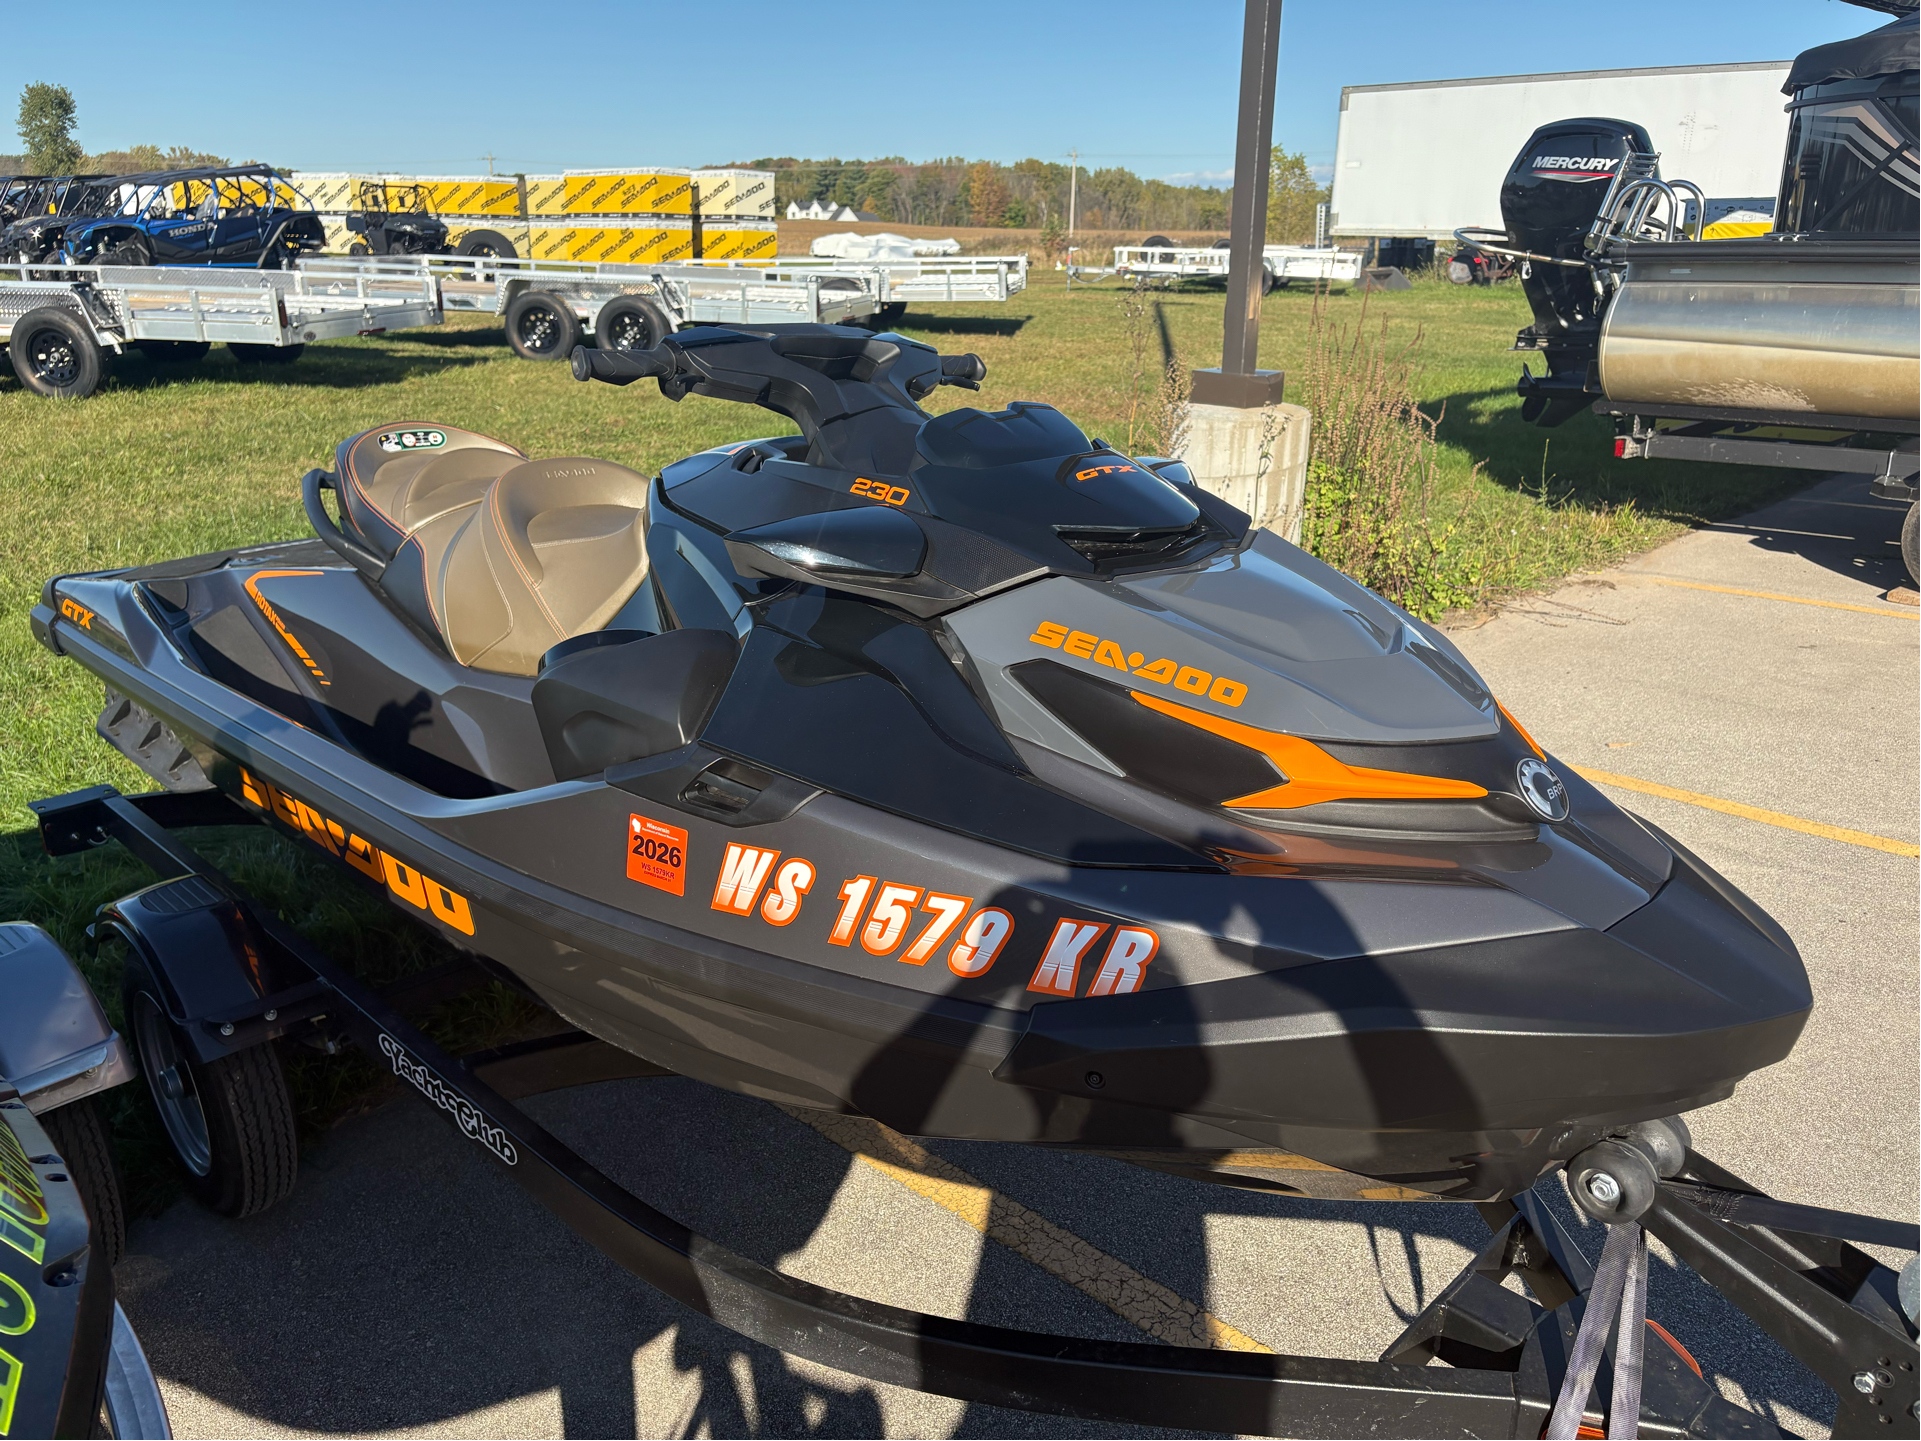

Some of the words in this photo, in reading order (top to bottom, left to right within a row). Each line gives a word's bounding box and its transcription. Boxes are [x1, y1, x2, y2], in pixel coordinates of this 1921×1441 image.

[1532, 156, 1618, 171] MERCURY
[168, 222, 215, 238] HONDA
[1076, 465, 1138, 482] GTX
[850, 478, 910, 506] 230
[61, 598, 95, 630] GTX
[255, 591, 277, 626] ROTAX
[1547, 783, 1563, 800] BRP
[646, 822, 670, 834] Wisconsin
[632, 834, 682, 868] 2026
[641, 862, 651, 871] WS
[711, 842, 817, 926] WS
[828, 874, 1016, 979] 1579
[1027, 917, 1161, 997] KR
